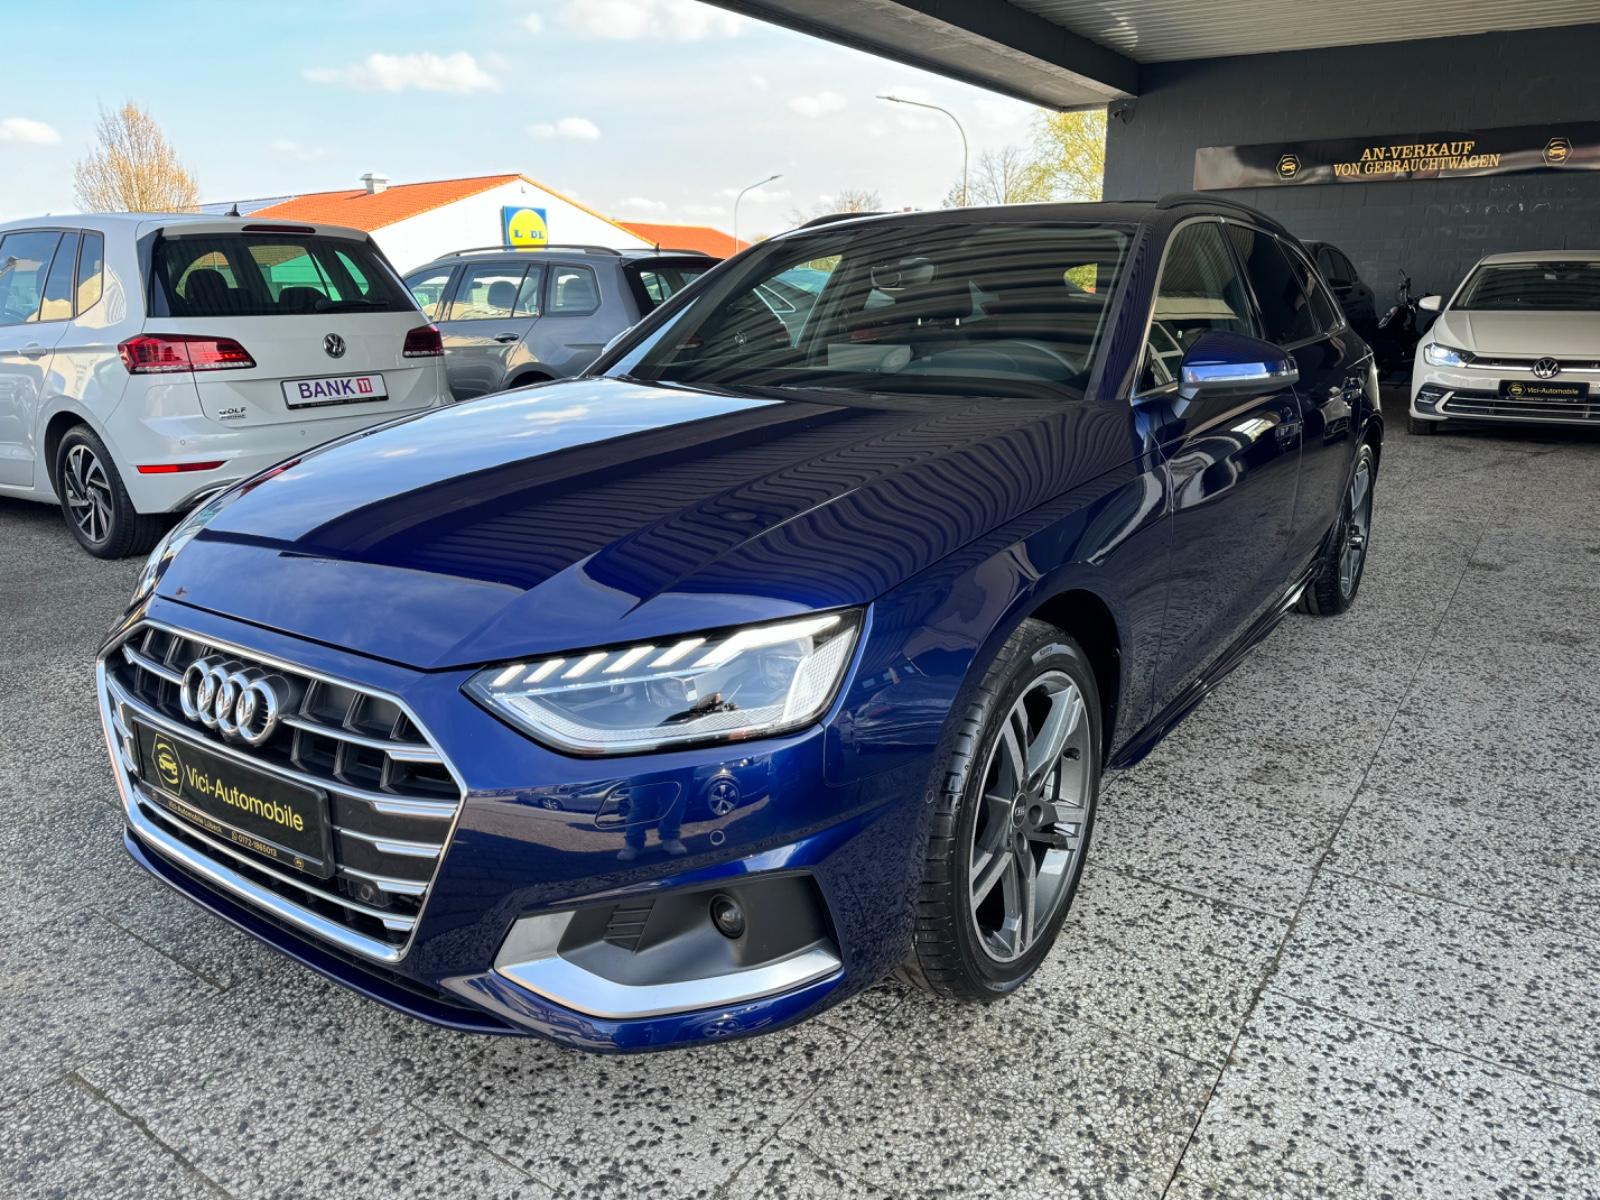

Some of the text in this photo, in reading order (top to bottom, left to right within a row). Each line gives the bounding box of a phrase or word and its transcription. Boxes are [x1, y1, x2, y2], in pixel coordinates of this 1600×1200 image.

[1360, 141, 1475, 161] AN-VERKAUF
[1333, 154, 1501, 177] VON GEBRAUCHTWAGEN
[512, 229, 544, 239] LDL
[298, 378, 372, 399] BANK 11
[186, 764, 304, 831] Vici-Automobile
